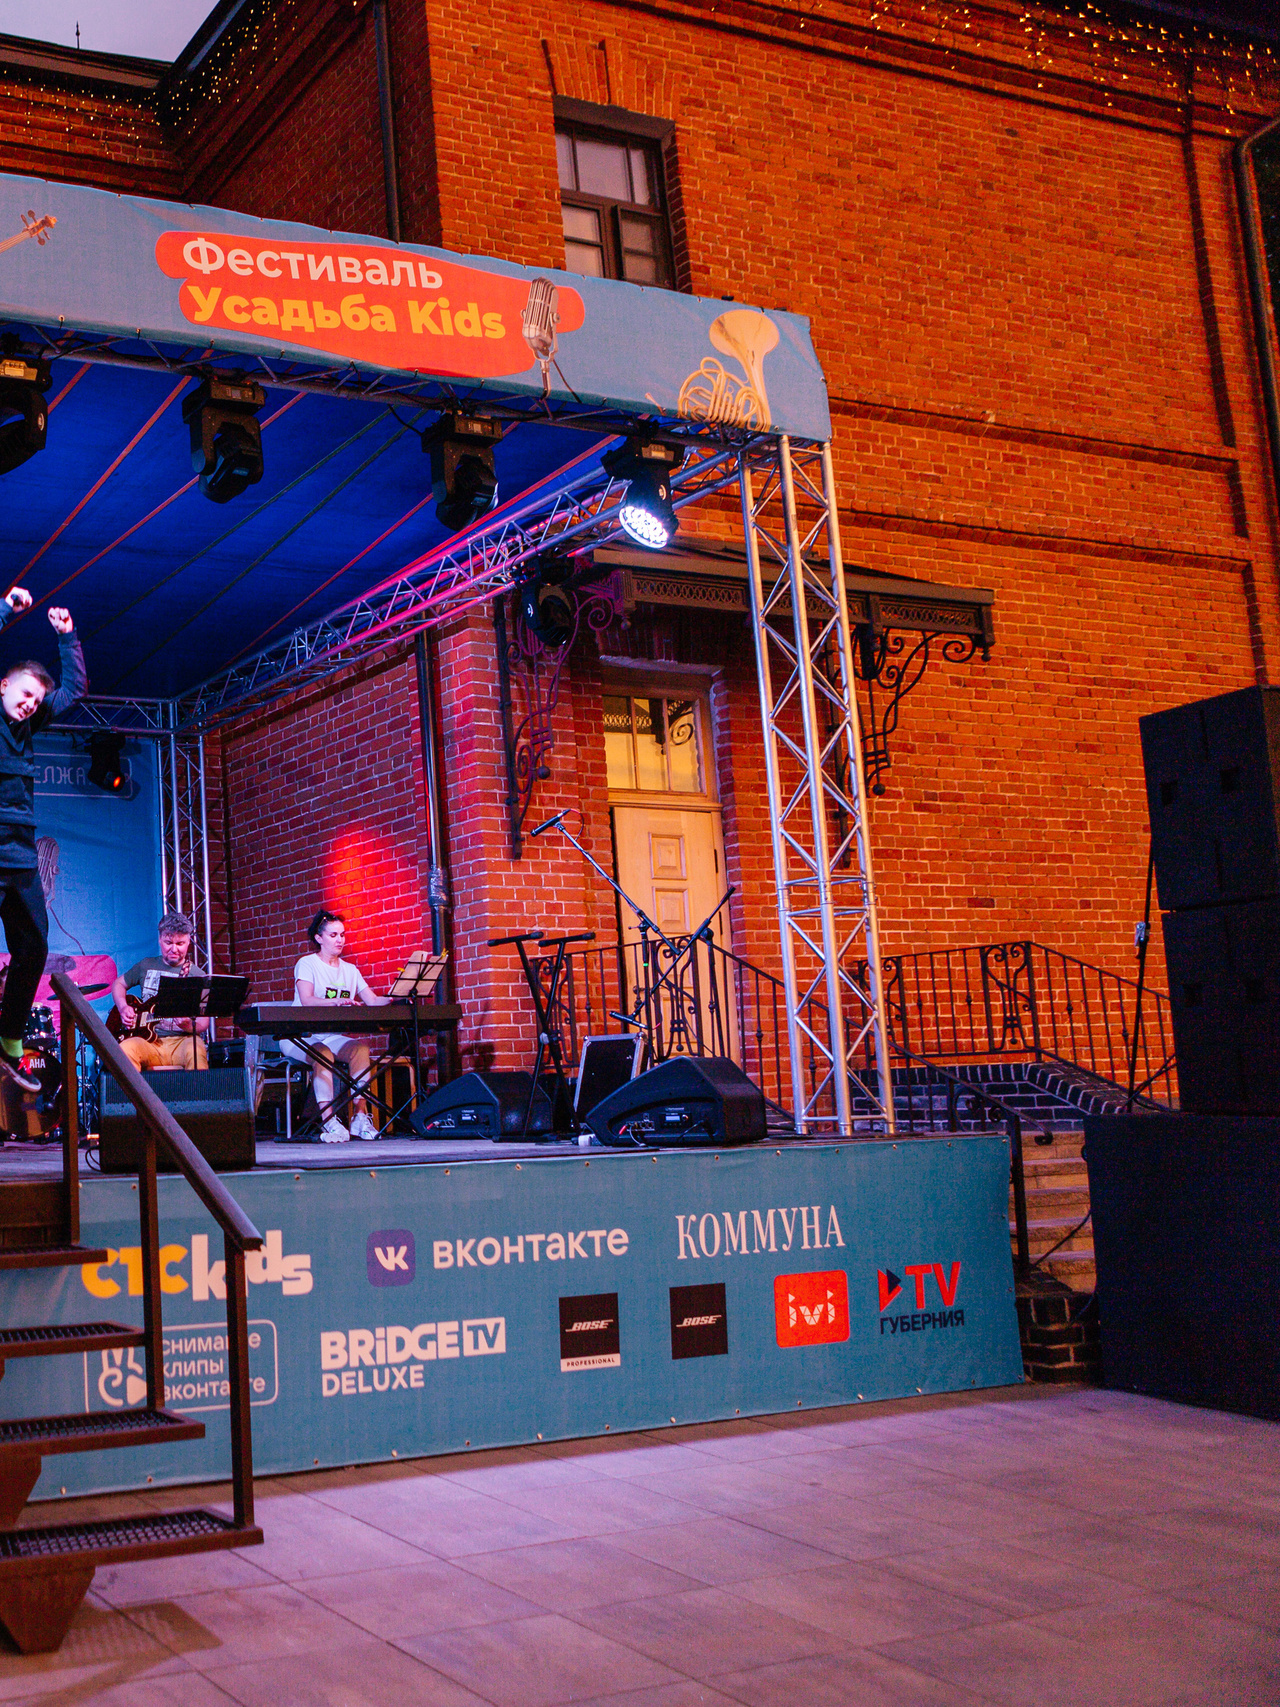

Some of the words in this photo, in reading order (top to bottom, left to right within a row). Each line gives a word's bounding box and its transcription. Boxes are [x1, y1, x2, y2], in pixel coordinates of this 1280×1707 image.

[182, 237, 443, 289] Фестиваль
[186, 285, 397, 333] Усадьба
[407, 297, 507, 339] Kids
[675, 1204, 846, 1260] КОММУНА
[905, 1261, 961, 1309] TV
[565, 1318, 614, 1333] BOSE
[676, 1314, 722, 1328] BOSE
[788, 1289, 836, 1328] ivi
[880, 1309, 965, 1335] ГУБЕРНИЯ
[566, 1357, 616, 1368] PROFESSIONAL
[322, 1364, 425, 1398] DELUXE
